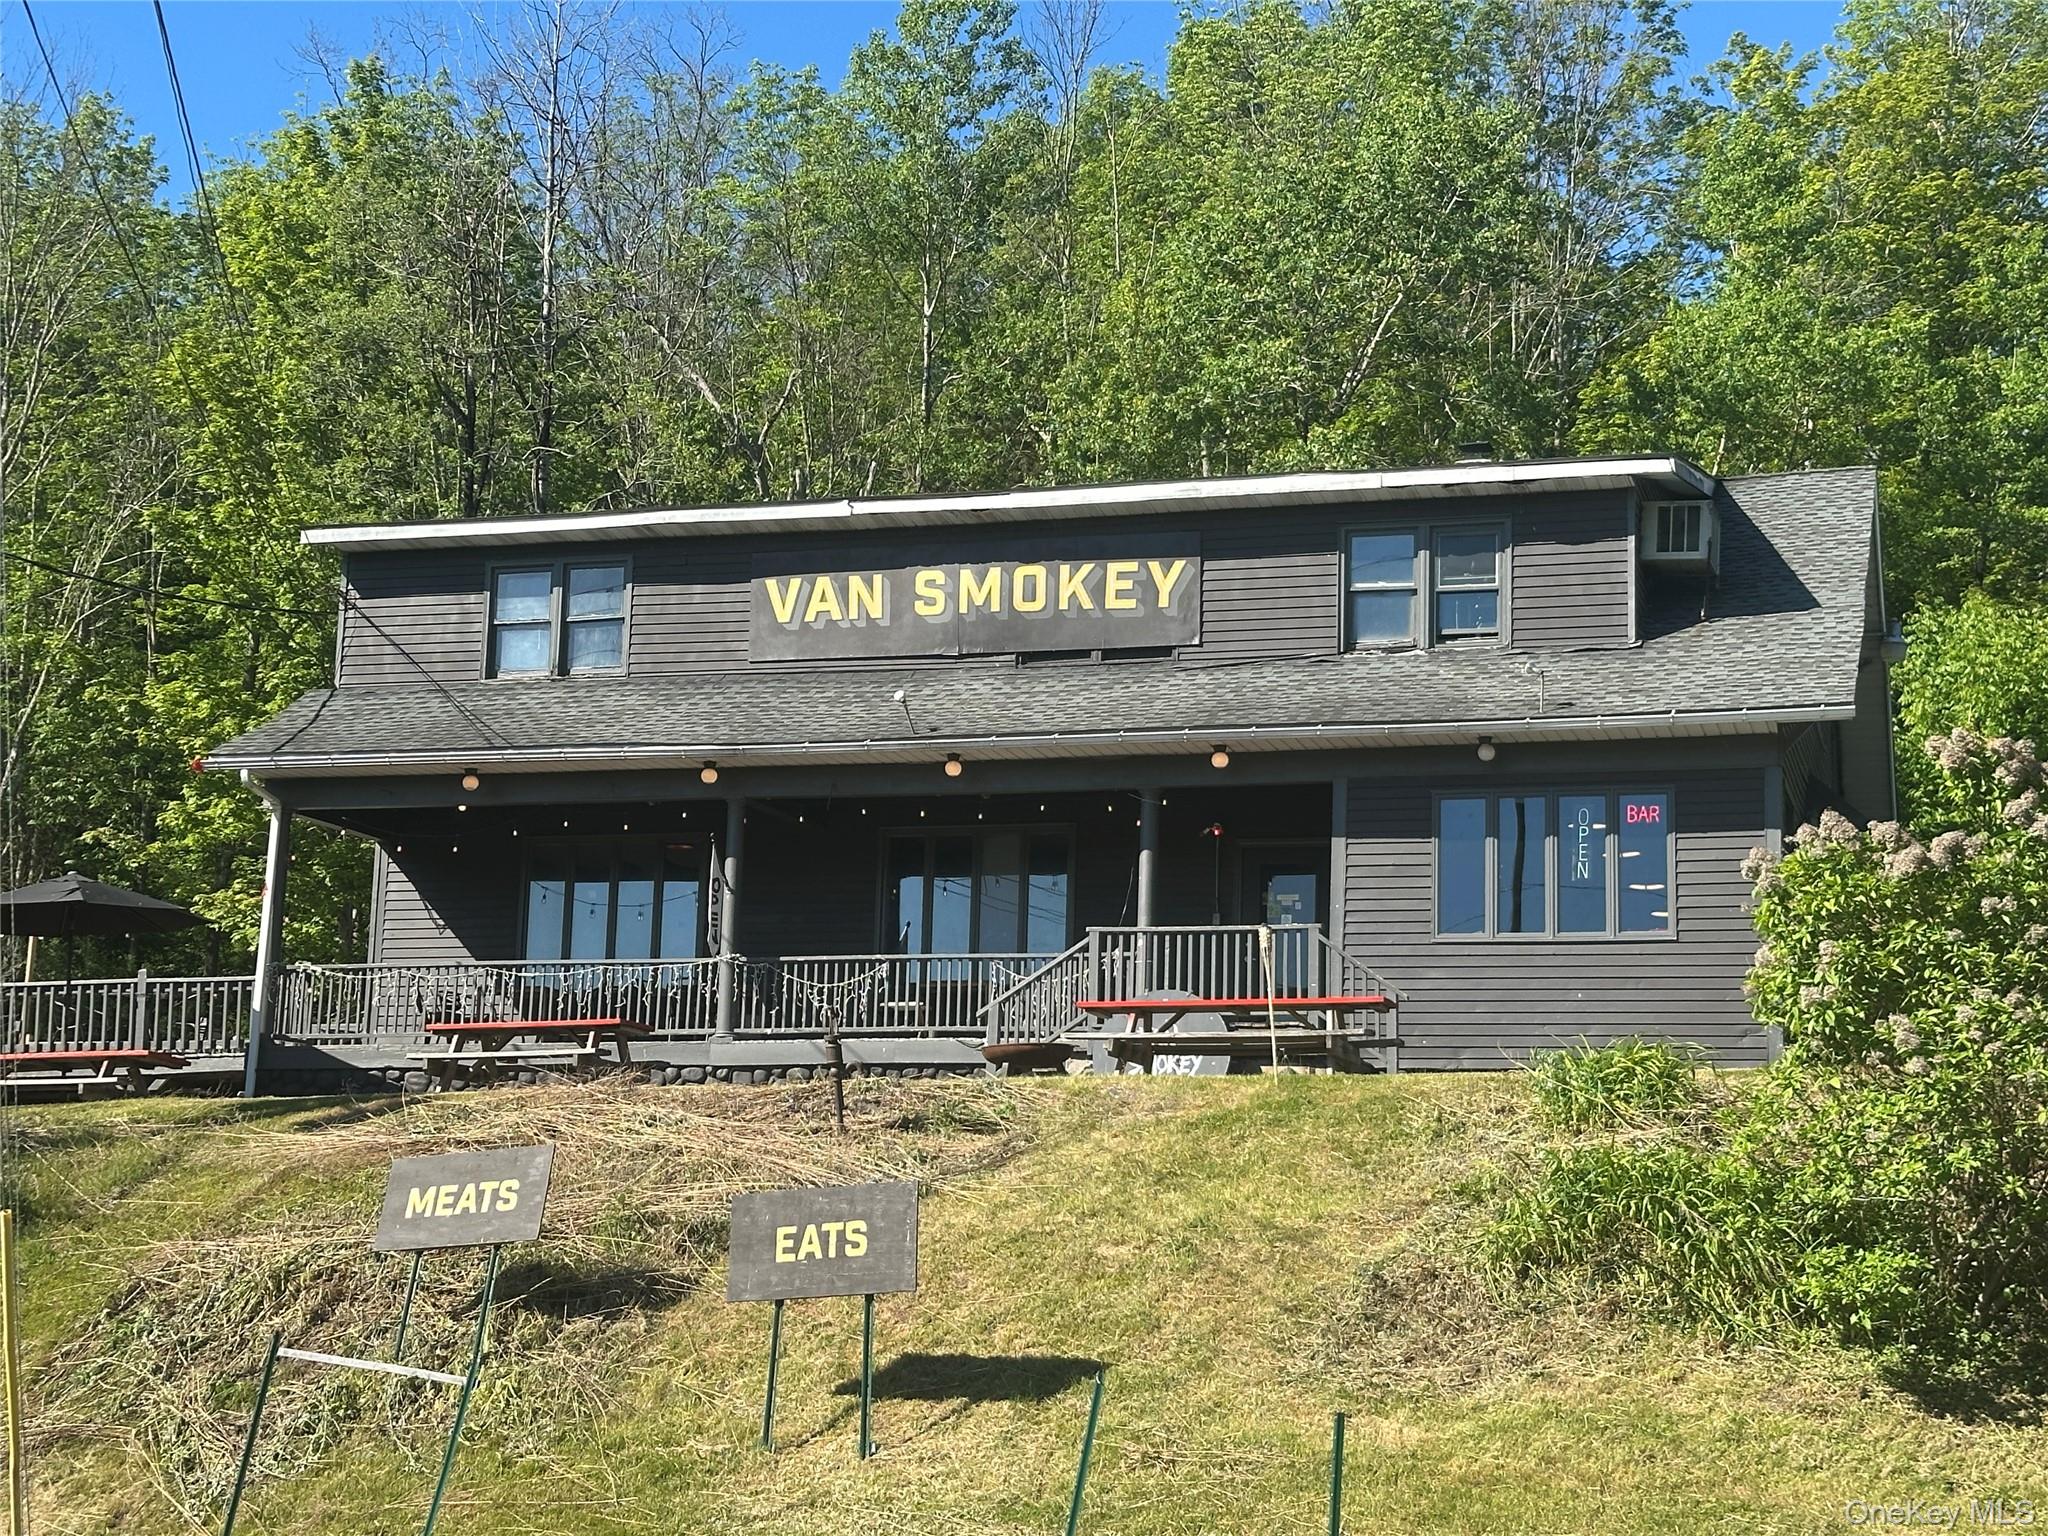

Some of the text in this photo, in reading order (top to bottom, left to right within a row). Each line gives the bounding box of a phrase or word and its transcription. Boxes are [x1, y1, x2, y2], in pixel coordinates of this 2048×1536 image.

[764, 560, 1188, 625] VAN SMOKEY
[1626, 804, 1660, 823] BAR
[1577, 808, 1589, 879] OPEN
[404, 1178, 519, 1219] MEATS
[775, 1219, 868, 1263] EATS
